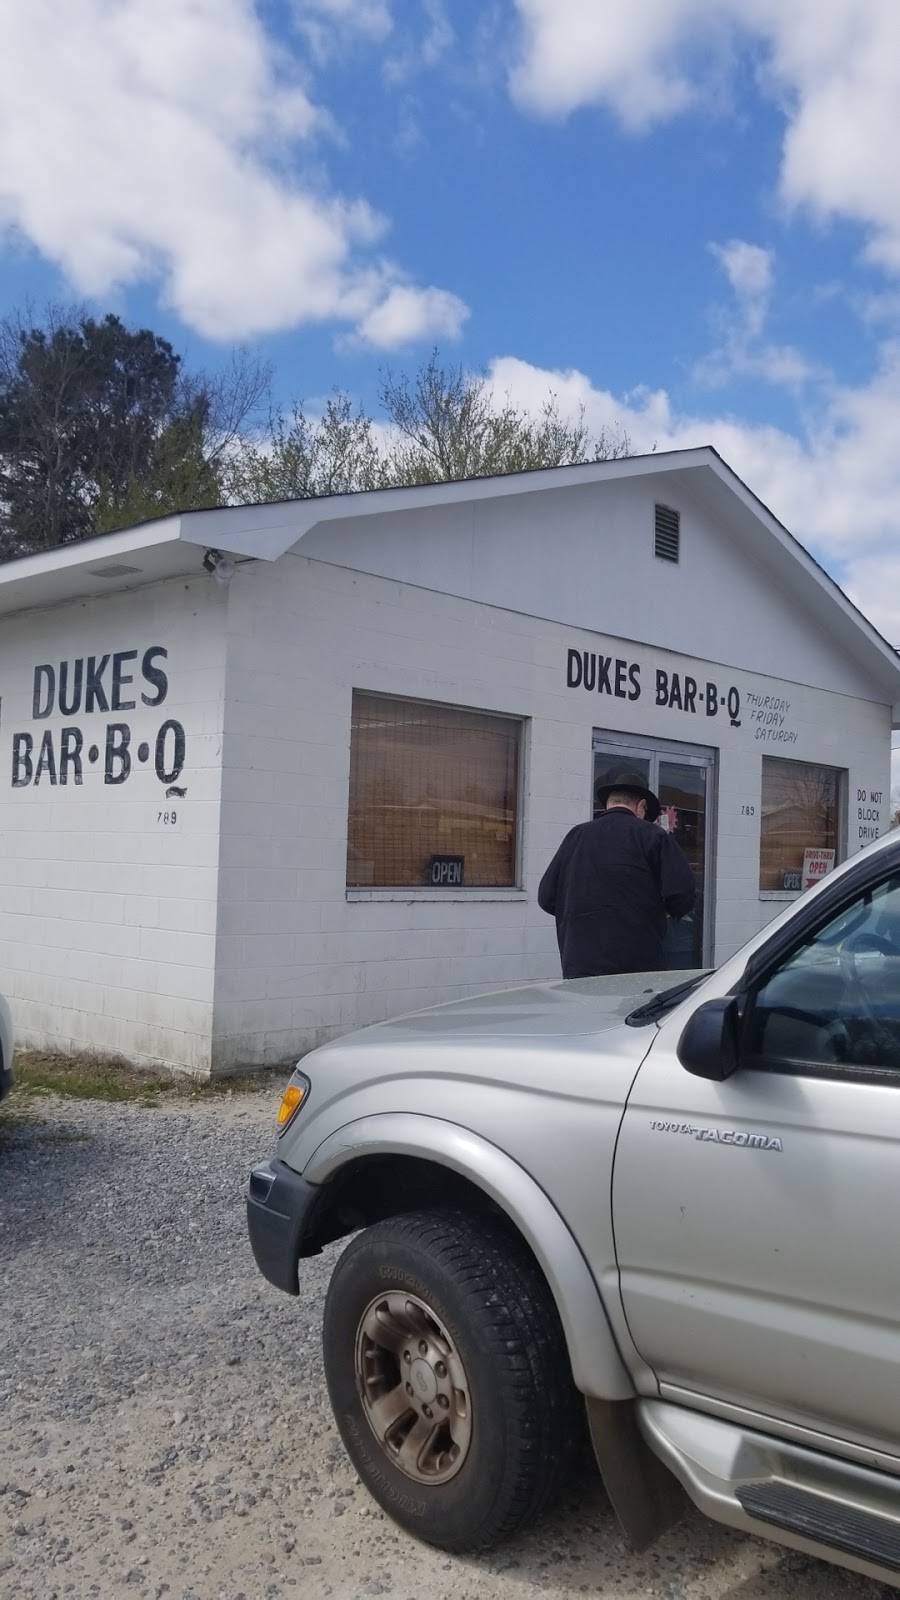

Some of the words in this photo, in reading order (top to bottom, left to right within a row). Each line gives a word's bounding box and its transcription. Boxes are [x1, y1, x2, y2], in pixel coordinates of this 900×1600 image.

[32, 645, 169, 720] DUKES
[566, 648, 641, 701] DUKES
[747, 692, 791, 712] THURSDAY
[751, 710, 785, 727] FRIDAY
[753, 727, 799, 743] SATURDAY
[857, 789, 867, 802] DO
[870, 792, 883, 804] NOT
[157, 811, 177, 825] 789
[741, 805, 755, 816] 789
[857, 809, 880, 822] BLOCK
[858, 828, 879, 839] DRIVE
[432, 861, 462, 883] OPEN
[809, 862, 828, 874] OPEN
[649, 1120, 693, 1135] TOYOTA
[695, 1127, 784, 1153] TACOMA
